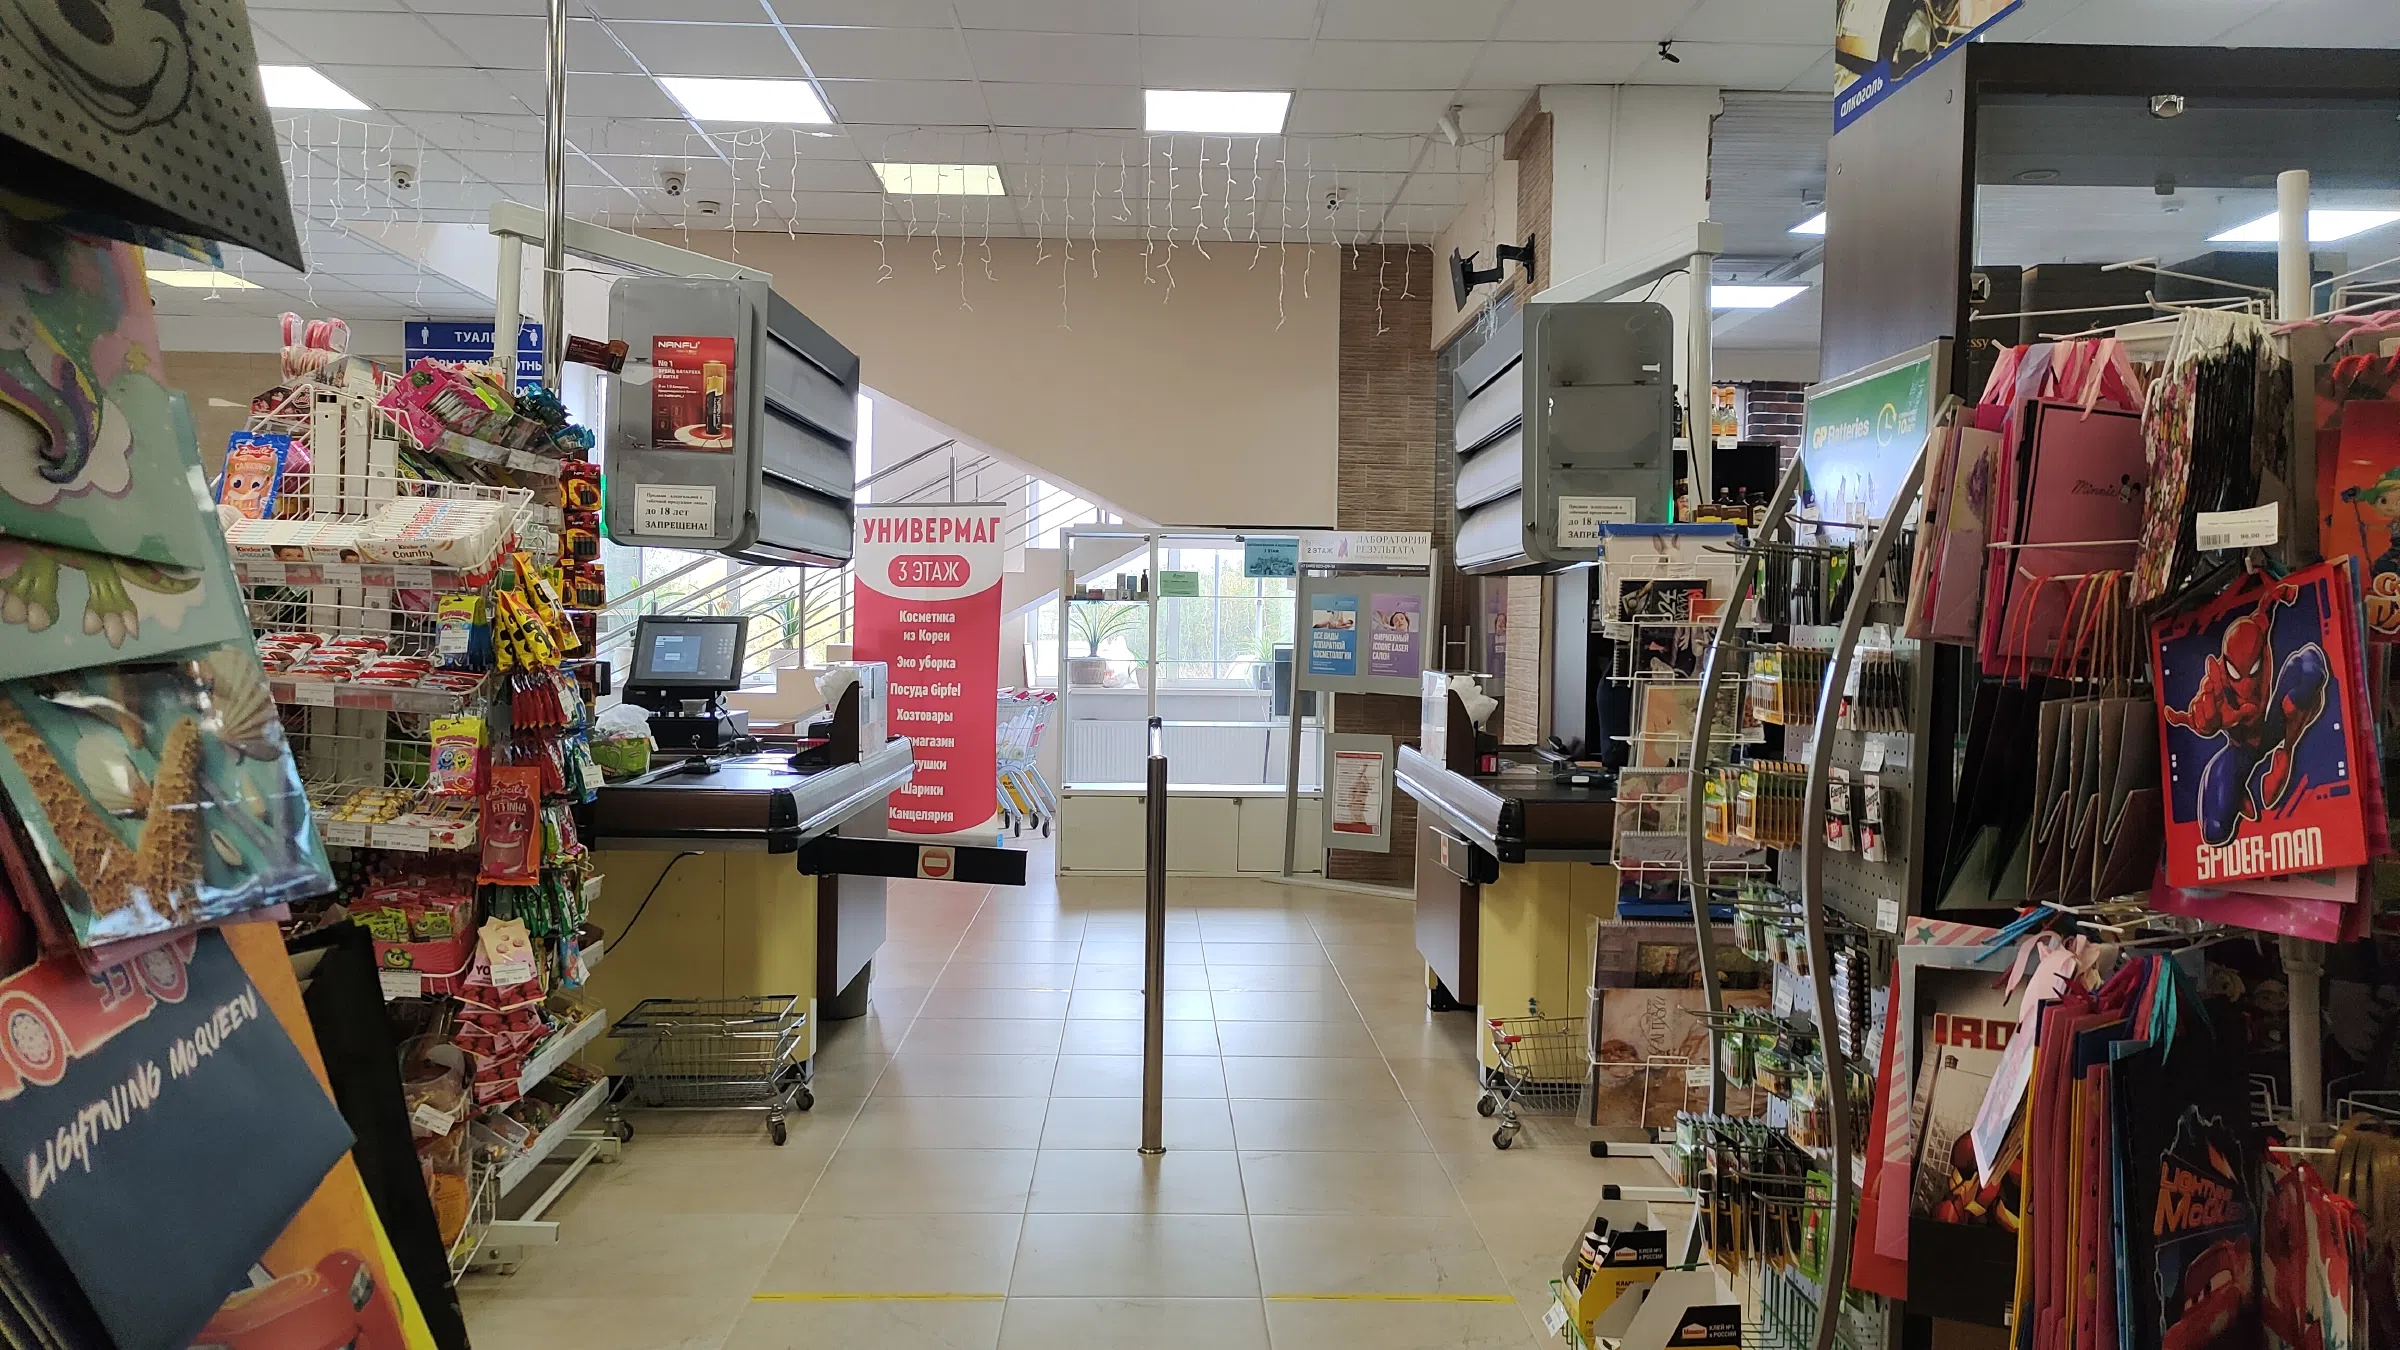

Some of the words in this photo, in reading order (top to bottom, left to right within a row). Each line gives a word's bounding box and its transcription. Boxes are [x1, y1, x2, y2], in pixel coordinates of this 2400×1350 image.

[1841, 76, 1883, 117] алкоголь
[658, 341, 698, 349] NANFU
[1813, 426, 1828, 449] GP
[1828, 417, 1870, 444] Batteries
[645, 508, 656, 516] до
[660, 506, 670, 515] 18
[645, 520, 708, 531] ЗАПРЕЩЕНА!
[1583, 517, 1592, 526] 18
[863, 517, 1000, 543] УНИВЕРМАГ
[1568, 531, 1599, 539] ЗАПРЕ
[1356, 535, 1428, 545] ЛАБОРАТОРИЯ
[393, 550, 434, 559] Country
[1313, 547, 1334, 555] ЭТАЖ
[1356, 545, 1416, 554] РЕЗУЛЬТАТА
[898, 561, 908, 581] 3
[912, 561, 960, 582] ЭТАЖ
[899, 610, 956, 623] Косметика
[903, 631, 916, 641] из
[918, 629, 950, 645] Кореи
[1373, 633, 1410, 643] ФИРМЕННЫЙ
[1312, 640, 1346, 650] АППАРАТНОЙ
[1392, 643, 1409, 653] LASER
[1312, 649, 1352, 660] КОСМЕТОЛОГИИ
[1372, 651, 1390, 661] САЛОН
[897, 655, 916, 668] Эко
[918, 654, 956, 672] уборка
[890, 682, 928, 698] Посуда
[930, 682, 961, 699] Gipfel
[896, 708, 954, 724] Хозтовары
[901, 736, 955, 748] магазин
[492, 783, 523, 796] Docile
[901, 782, 944, 798] Шарики
[492, 801, 527, 813] FITINHA
[889, 806, 954, 824] Канцелярия
[2196, 826, 2323, 881] SPIDER-MAN
[1934, 1012, 2019, 1052] IRO
[28, 1061, 162, 1200] LIGHTNING
[168, 984, 258, 1080] McQUEEN
[1713, 1330, 1737, 1338] РОССИИ
